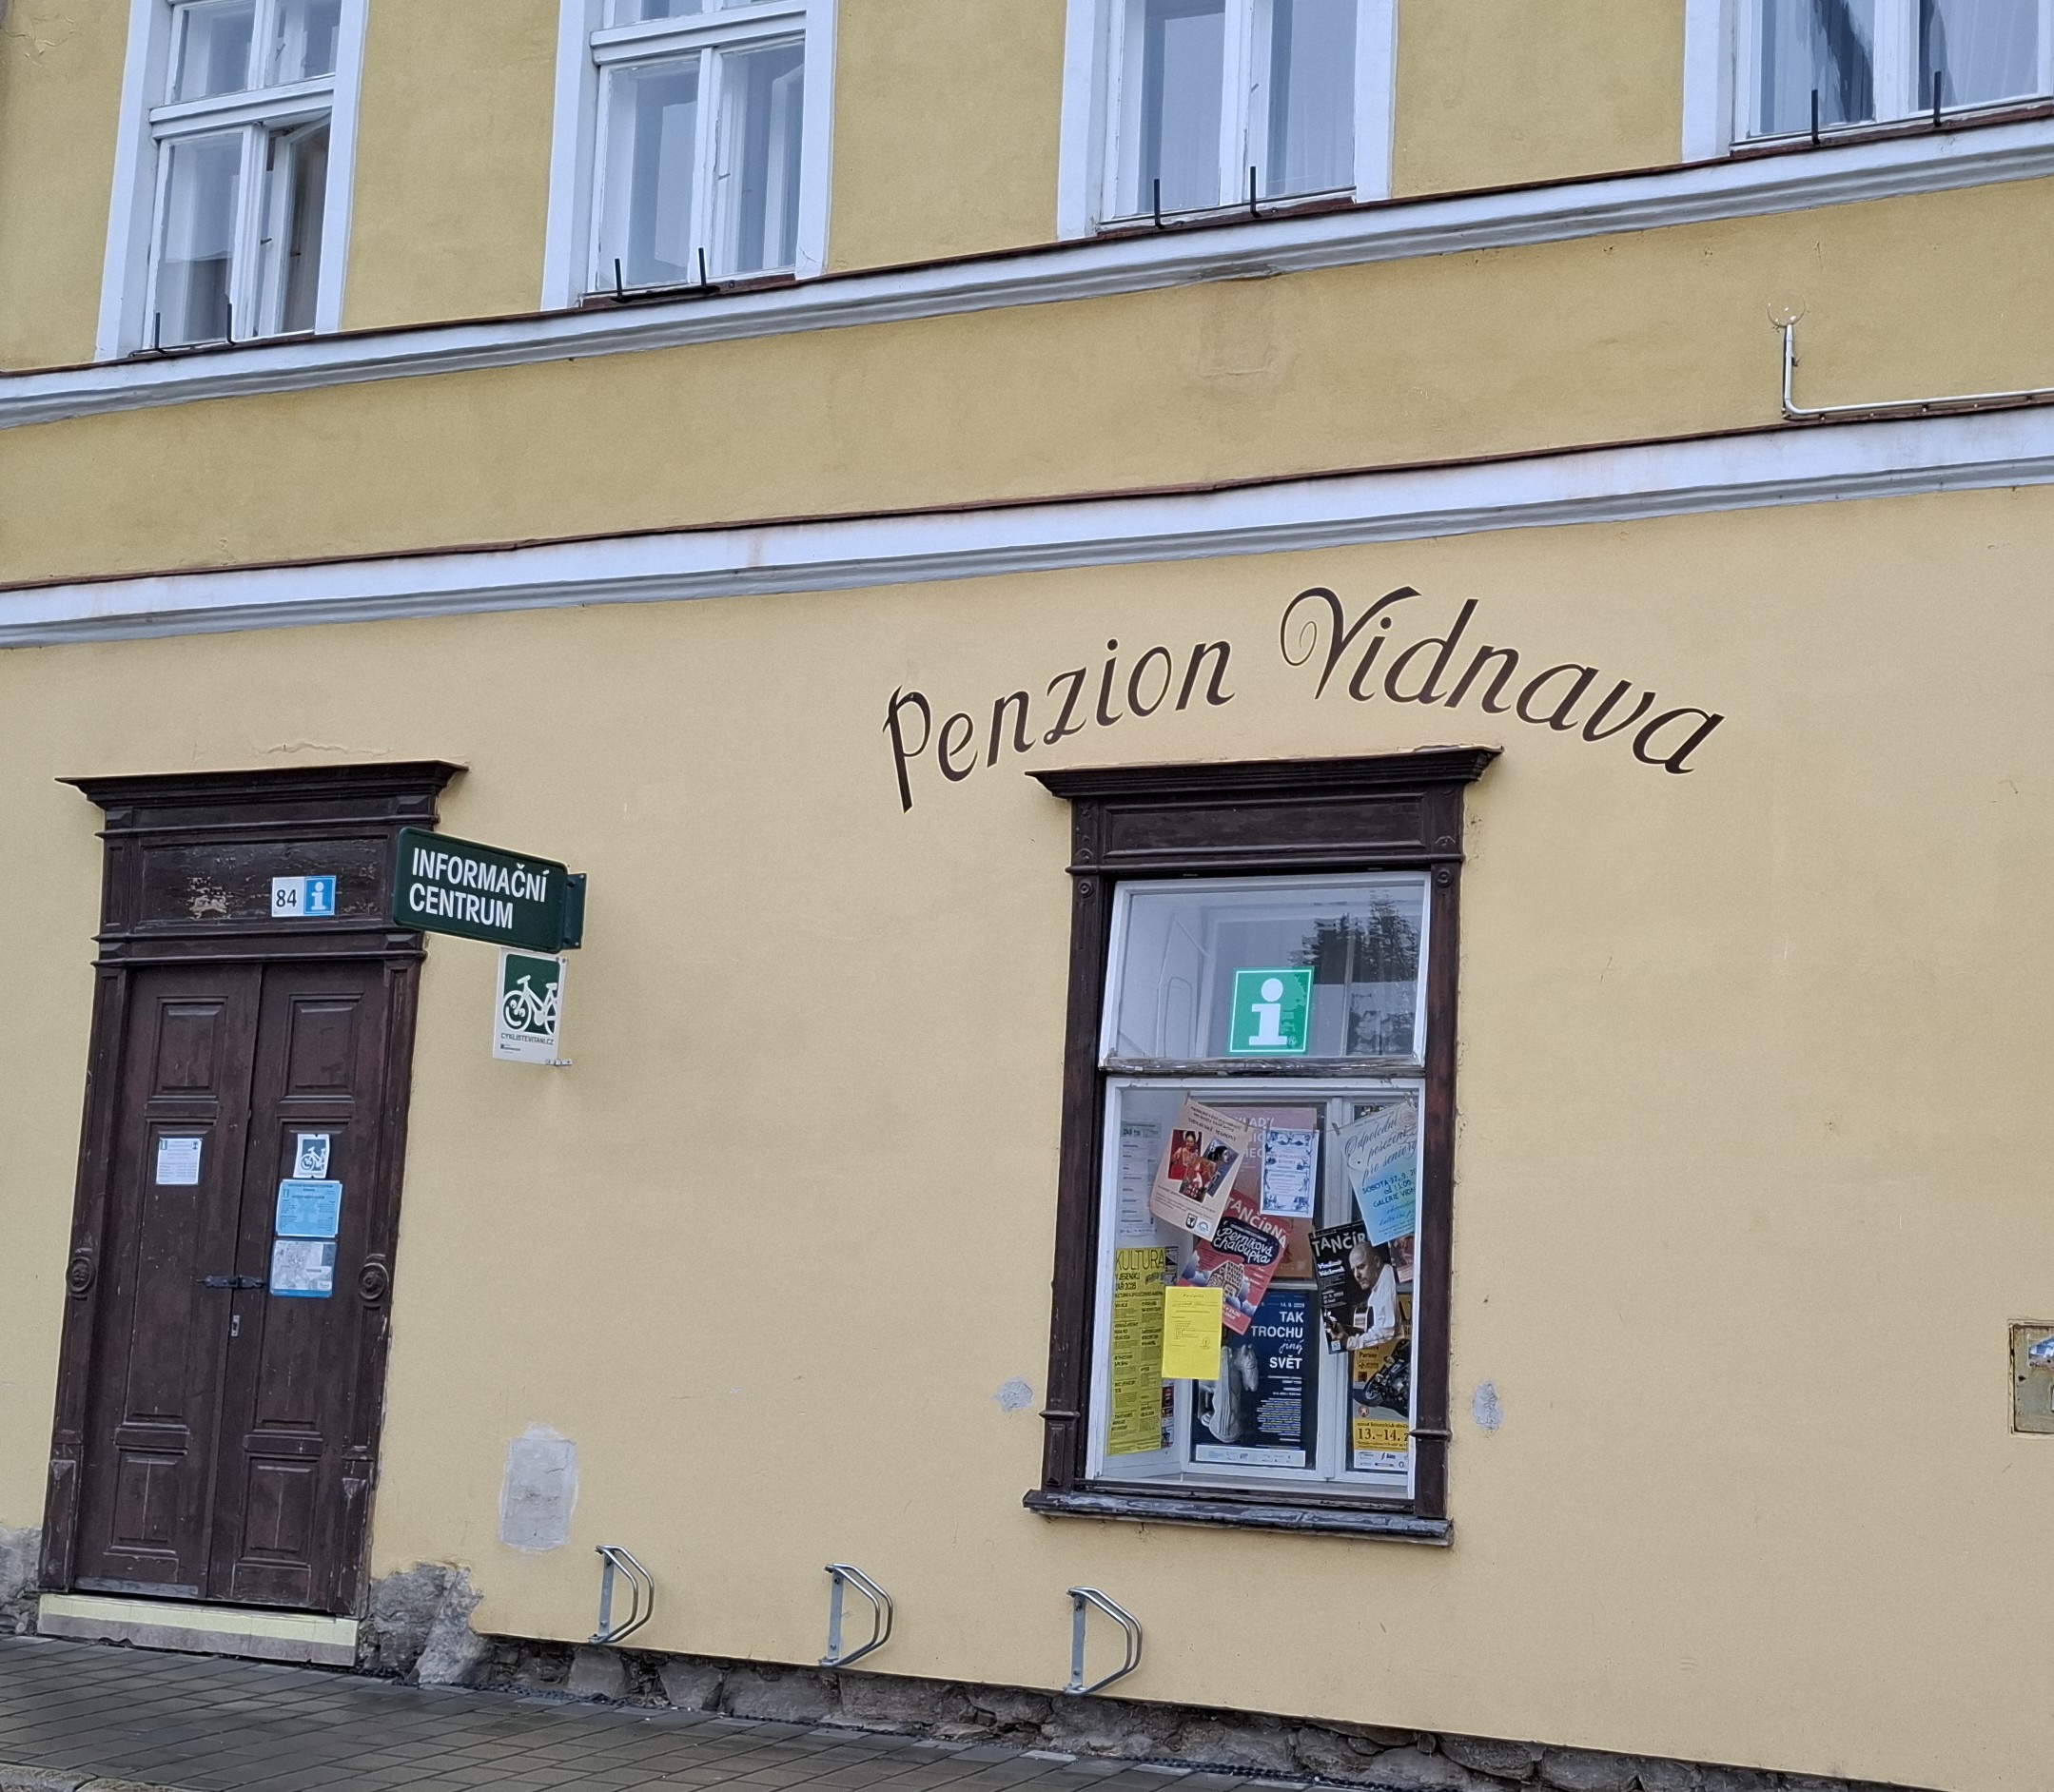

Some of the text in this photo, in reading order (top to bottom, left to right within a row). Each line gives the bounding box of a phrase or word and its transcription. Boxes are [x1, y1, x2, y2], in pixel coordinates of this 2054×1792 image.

[882, 585, 1726, 813] Penzion Vidnava
[412, 847, 550, 903] INFORMAČNÍ
[276, 888, 297, 907] 84
[409, 883, 514, 929] CENTRUM
[1312, 1231, 1366, 1257] TANČÍR
[1115, 1249, 1164, 1271] KULTURA
[1280, 1311, 1304, 1323] TAK
[1251, 1325, 1303, 1338] TROCHU
[1269, 1354, 1302, 1370] SVĚT
